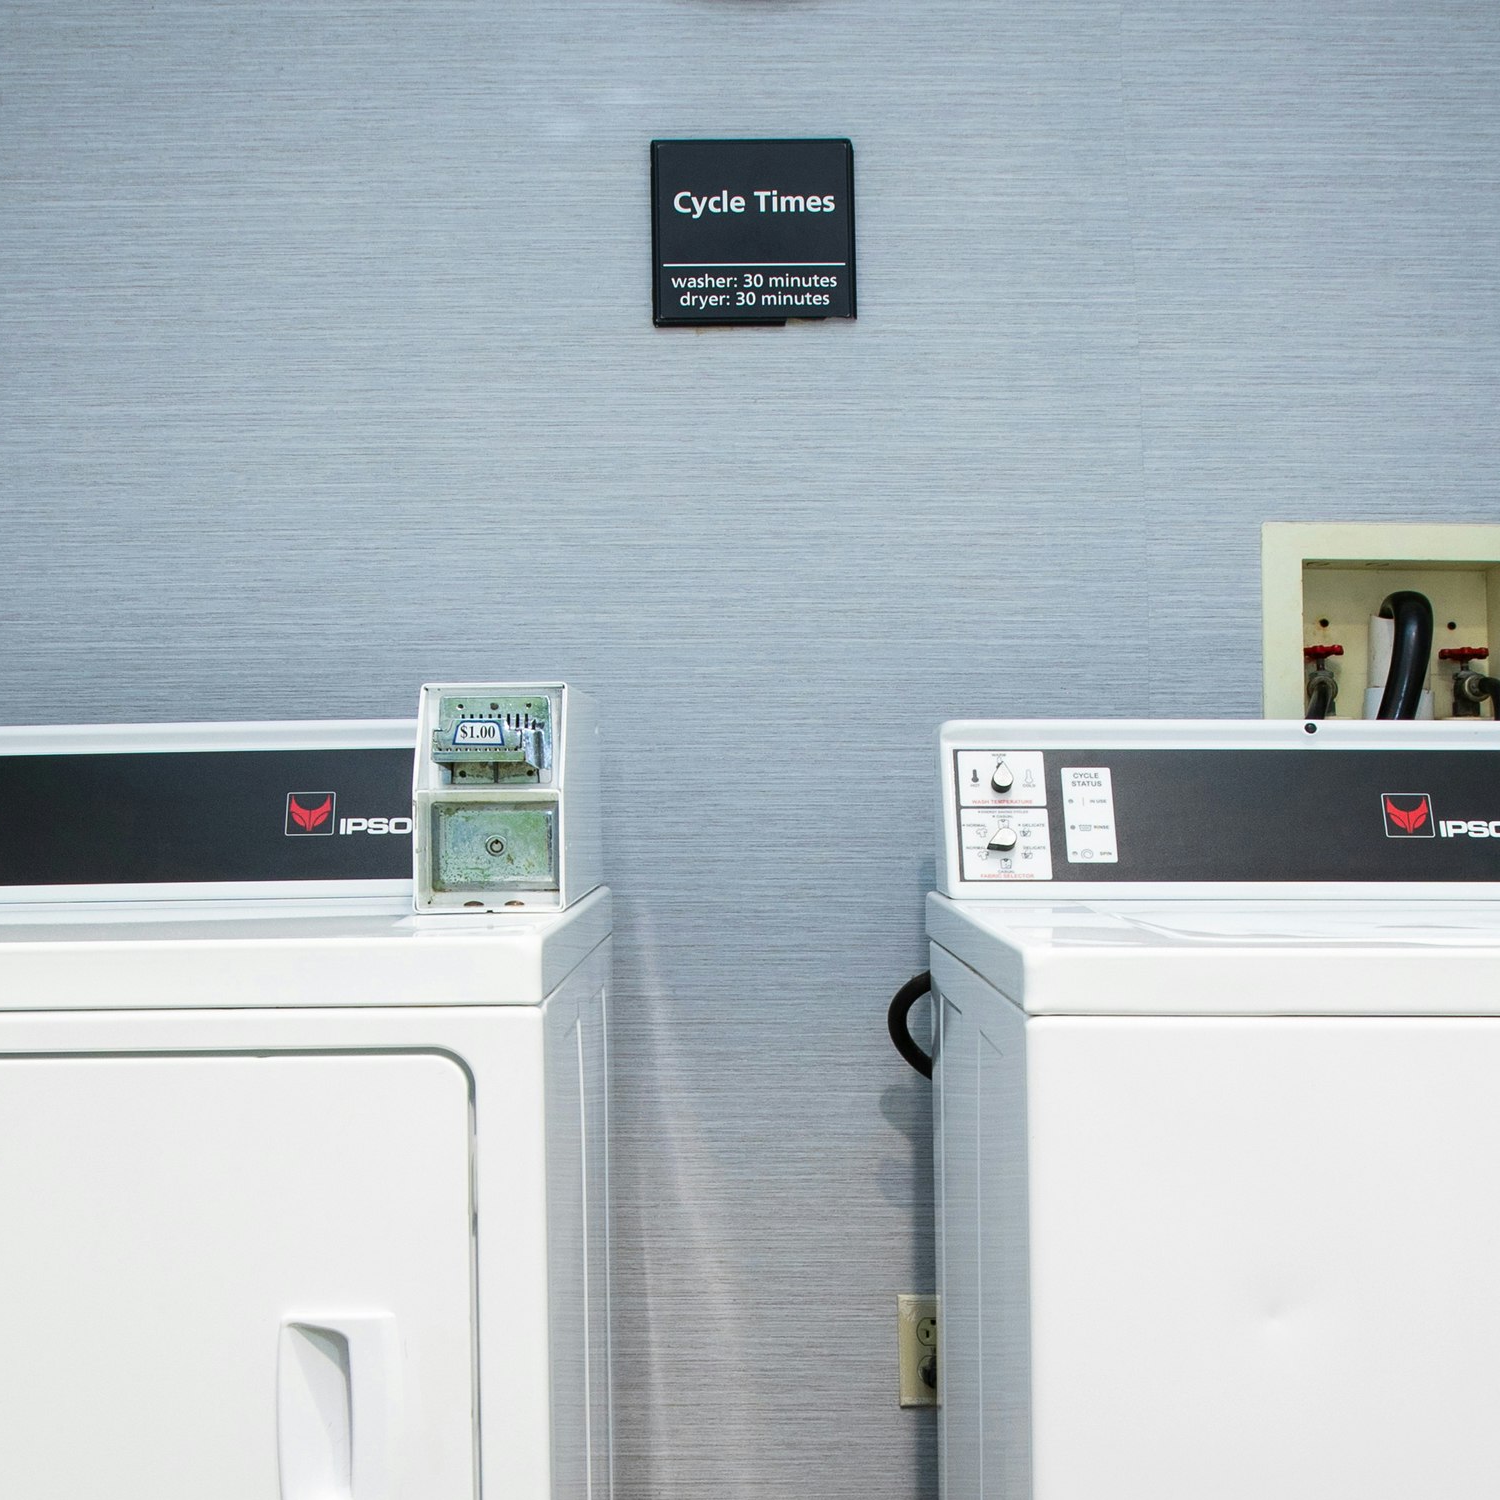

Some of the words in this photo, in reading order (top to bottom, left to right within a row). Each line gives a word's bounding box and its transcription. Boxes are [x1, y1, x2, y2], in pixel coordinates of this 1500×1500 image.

[673, 190, 746, 219] Cycle
[753, 190, 836, 213] Times
[671, 273, 738, 288] washer:
[743, 273, 764, 288] 30
[769, 273, 838, 288] minutes
[679, 291, 731, 310] dryer:
[735, 291, 756, 306] 30
[761, 291, 830, 306] minutes
[460, 725, 496, 740] $1.00
[339, 817, 413, 835] IPSO
